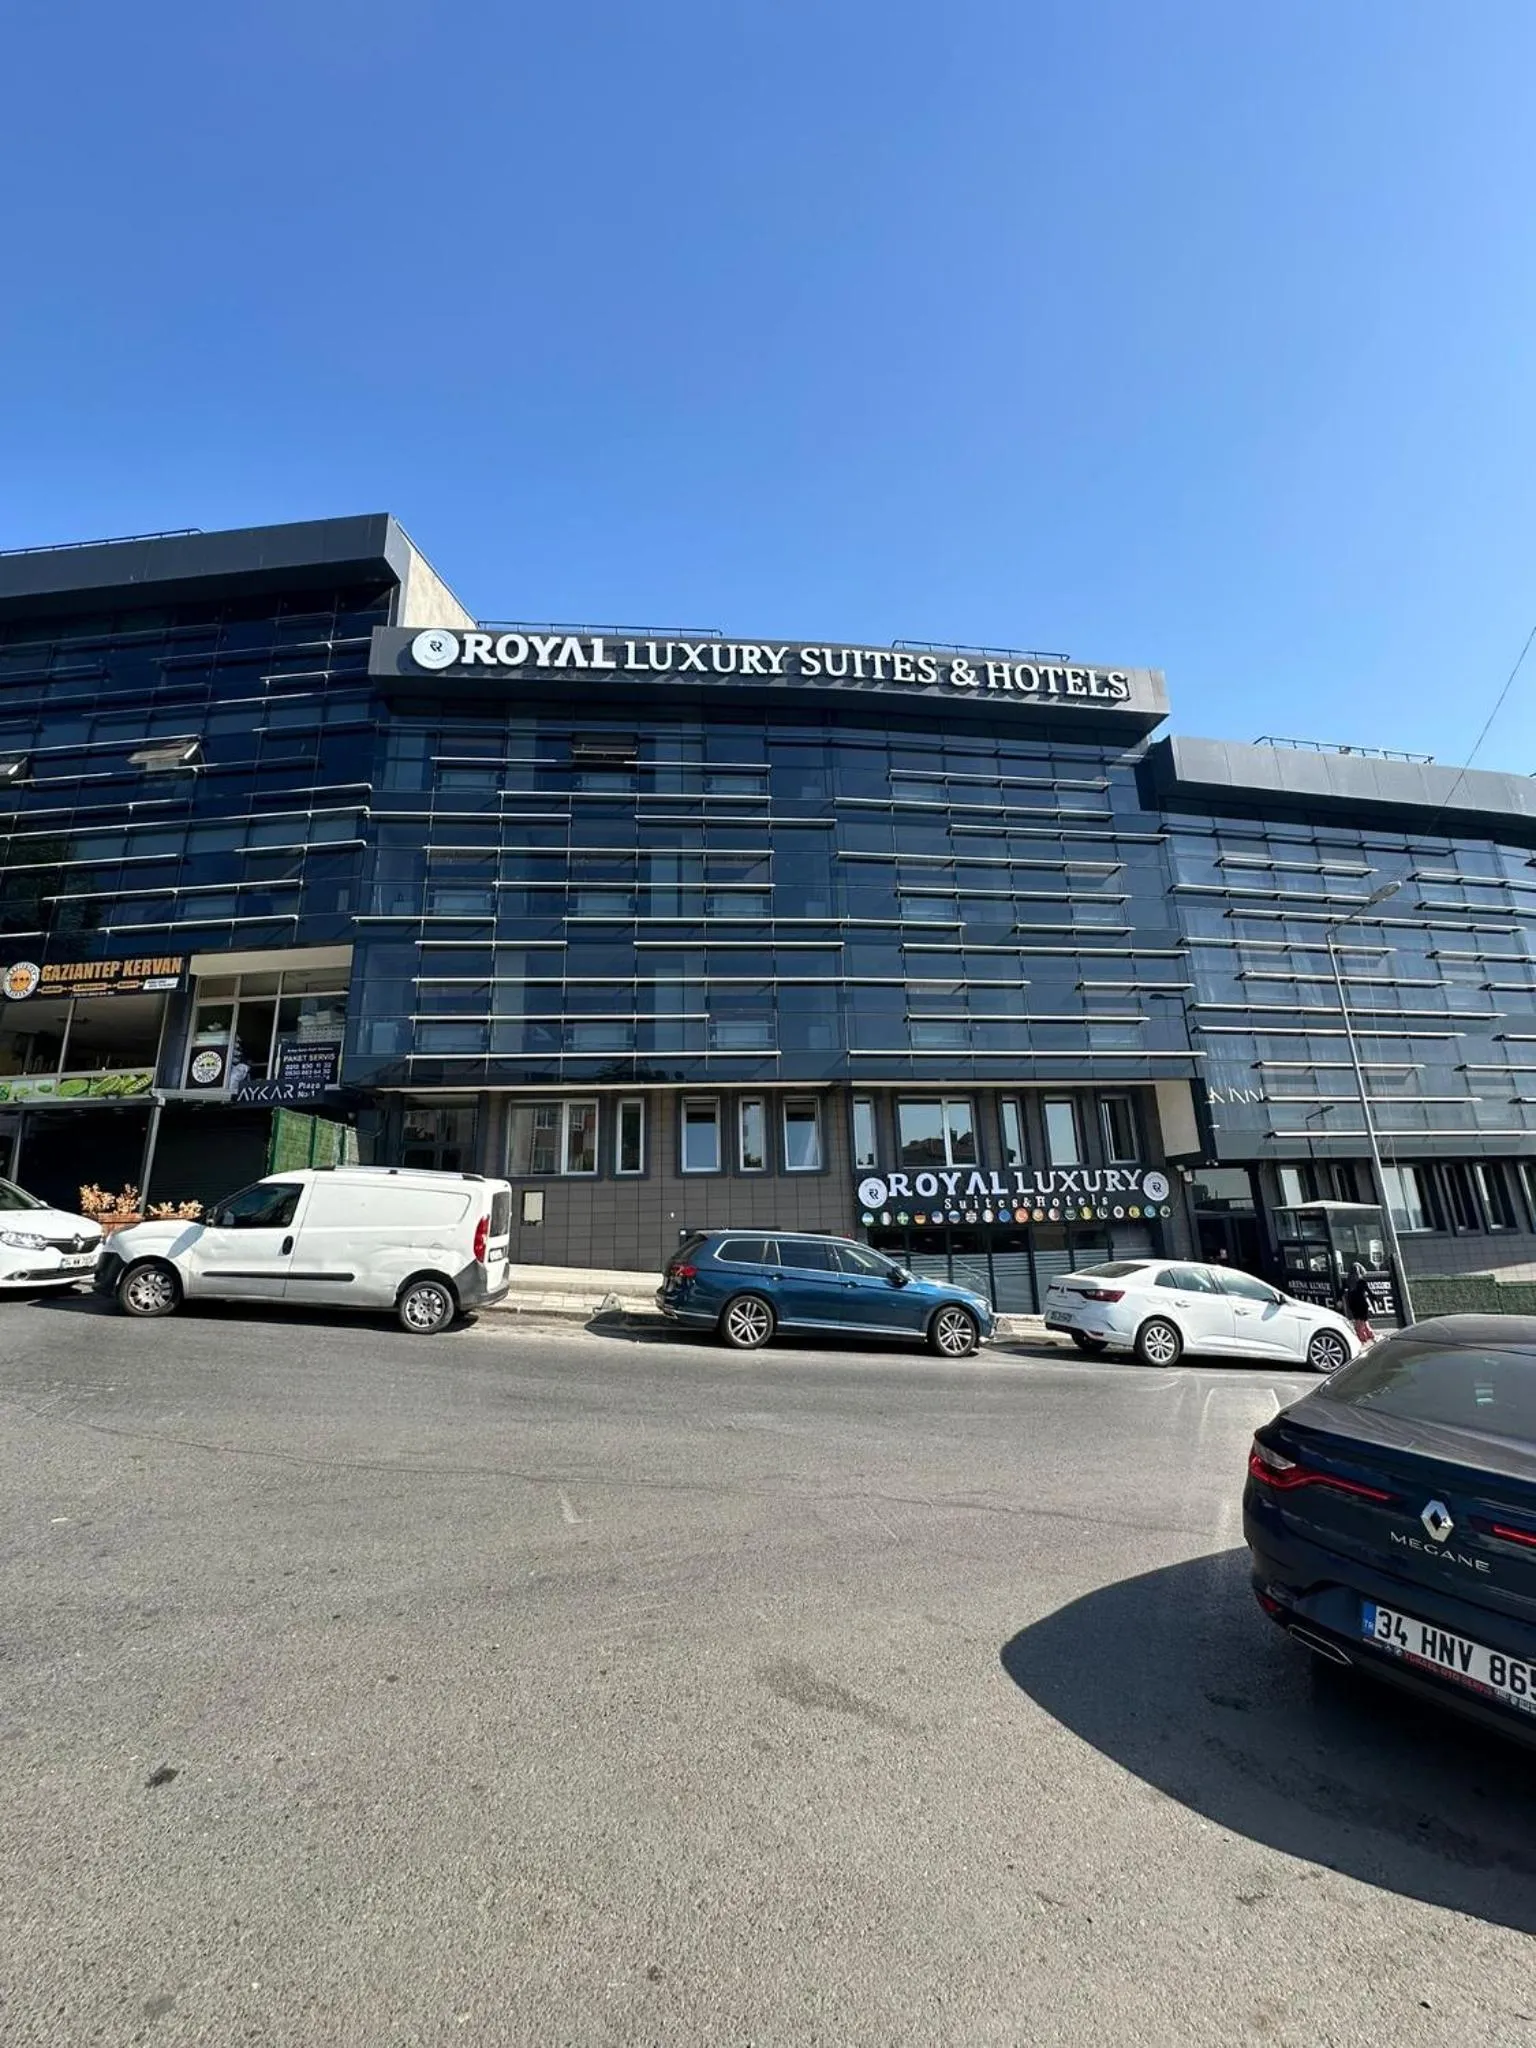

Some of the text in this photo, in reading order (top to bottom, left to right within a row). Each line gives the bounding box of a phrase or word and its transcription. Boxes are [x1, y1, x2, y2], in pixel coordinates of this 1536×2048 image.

[461, 633, 1129, 700] ROYAL LUXURY SUITES & HOTELS
[122, 957, 183, 977] KERVAN
[237, 1084, 294, 1101] AYKAR
[887, 1169, 1142, 1197] ROYAL LUXURY
[1390, 1531, 1491, 1573] MEGANE
[1377, 1610, 1408, 1647] 34
[1421, 1625, 1474, 1673] HNV
